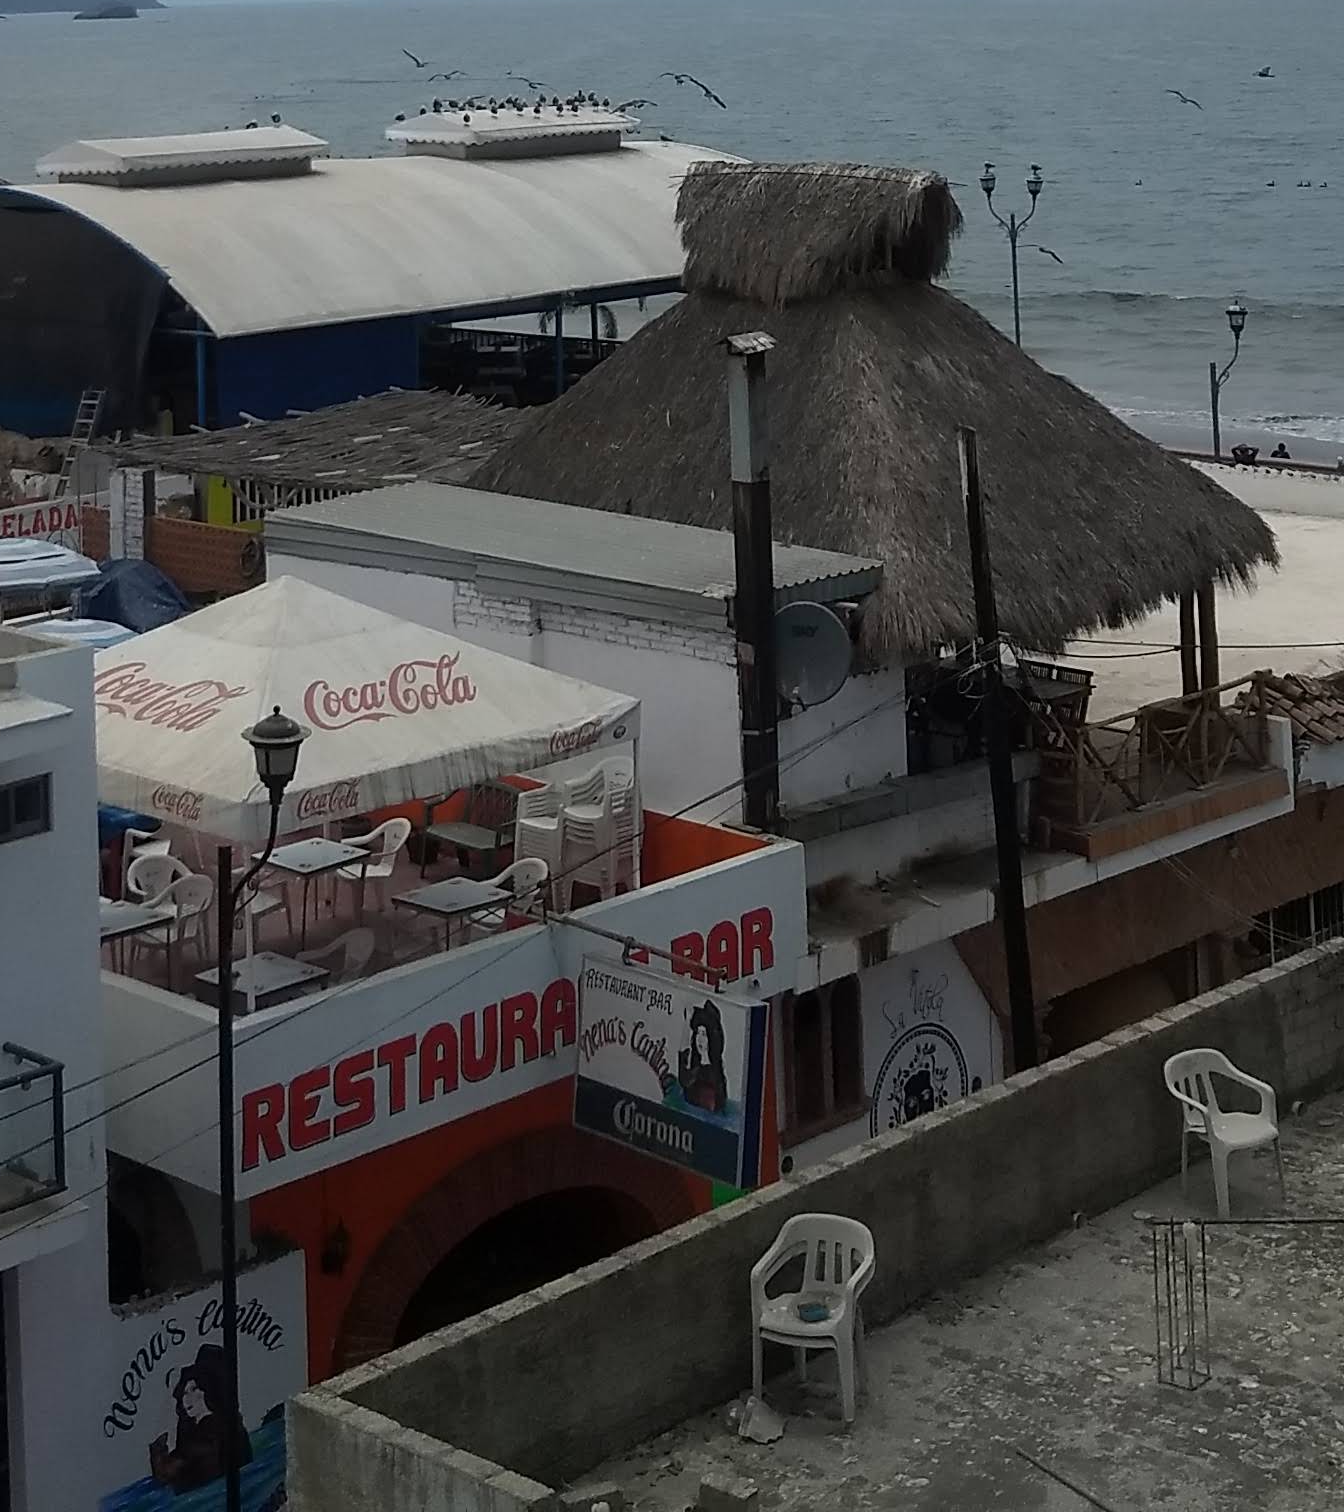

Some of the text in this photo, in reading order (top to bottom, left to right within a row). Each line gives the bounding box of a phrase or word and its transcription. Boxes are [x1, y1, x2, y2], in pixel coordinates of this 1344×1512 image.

[303, 651, 477, 730] Coca-Cola
[152, 784, 205, 821] Coca-Cola
[297, 778, 361, 820] Coca-Cola
[584, 968, 673, 1015] RESTAURANT BAR
[241, 905, 775, 1172] RESTAURA BAR
[610, 1098, 695, 1154] Corona
